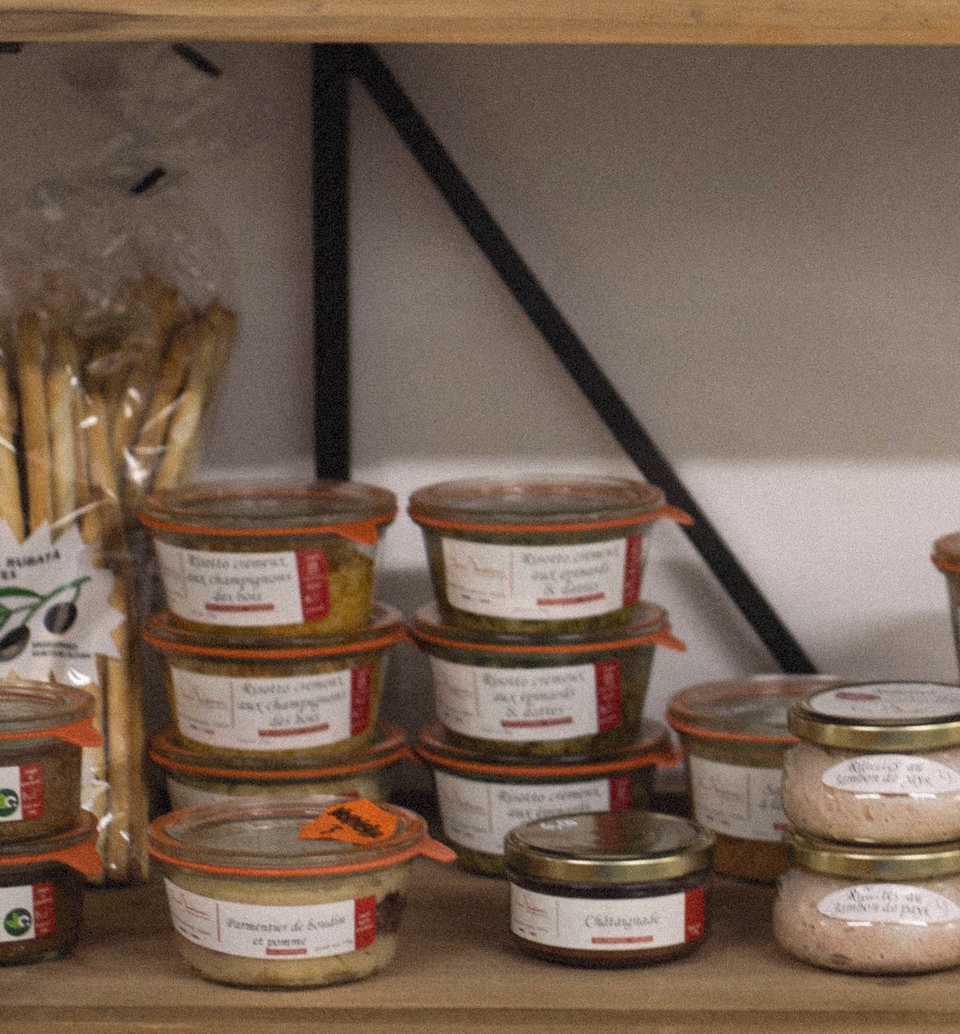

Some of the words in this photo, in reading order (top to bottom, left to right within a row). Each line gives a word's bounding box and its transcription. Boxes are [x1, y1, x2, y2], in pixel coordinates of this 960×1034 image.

[290, 919, 303, 933] de
[252, 934, 265, 947] et
[266, 937, 307, 951] pomme
